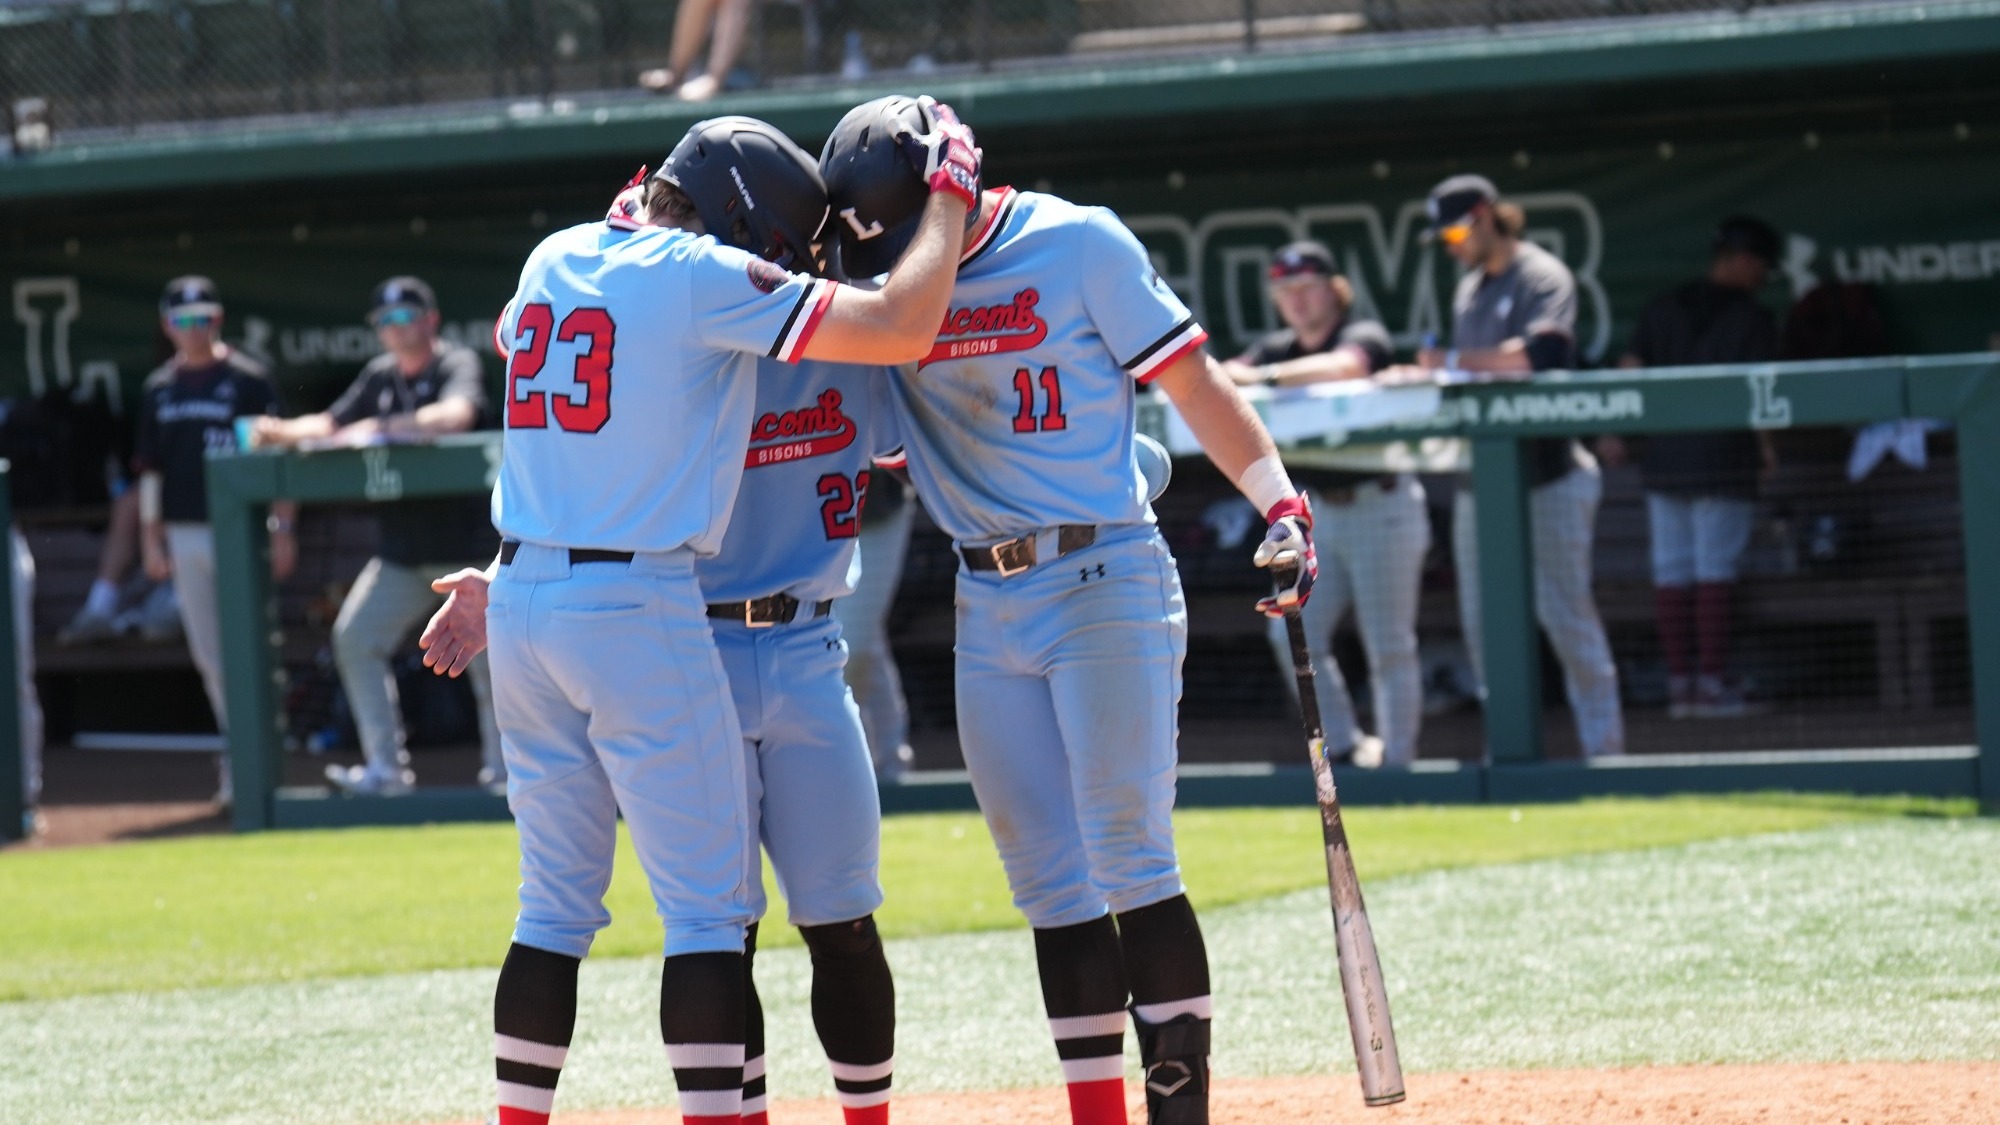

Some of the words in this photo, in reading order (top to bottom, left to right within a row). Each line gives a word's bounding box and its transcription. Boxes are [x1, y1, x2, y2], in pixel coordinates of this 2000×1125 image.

[839, 207, 885, 241] L
[950, 338, 998, 357] BISONS
[507, 303, 616, 433] 23
[1012, 365, 1067, 434] 11
[1488, 390, 1643, 425] ARMOUR
[1748, 370, 1791, 428] L
[758, 442, 813, 464] BISONS
